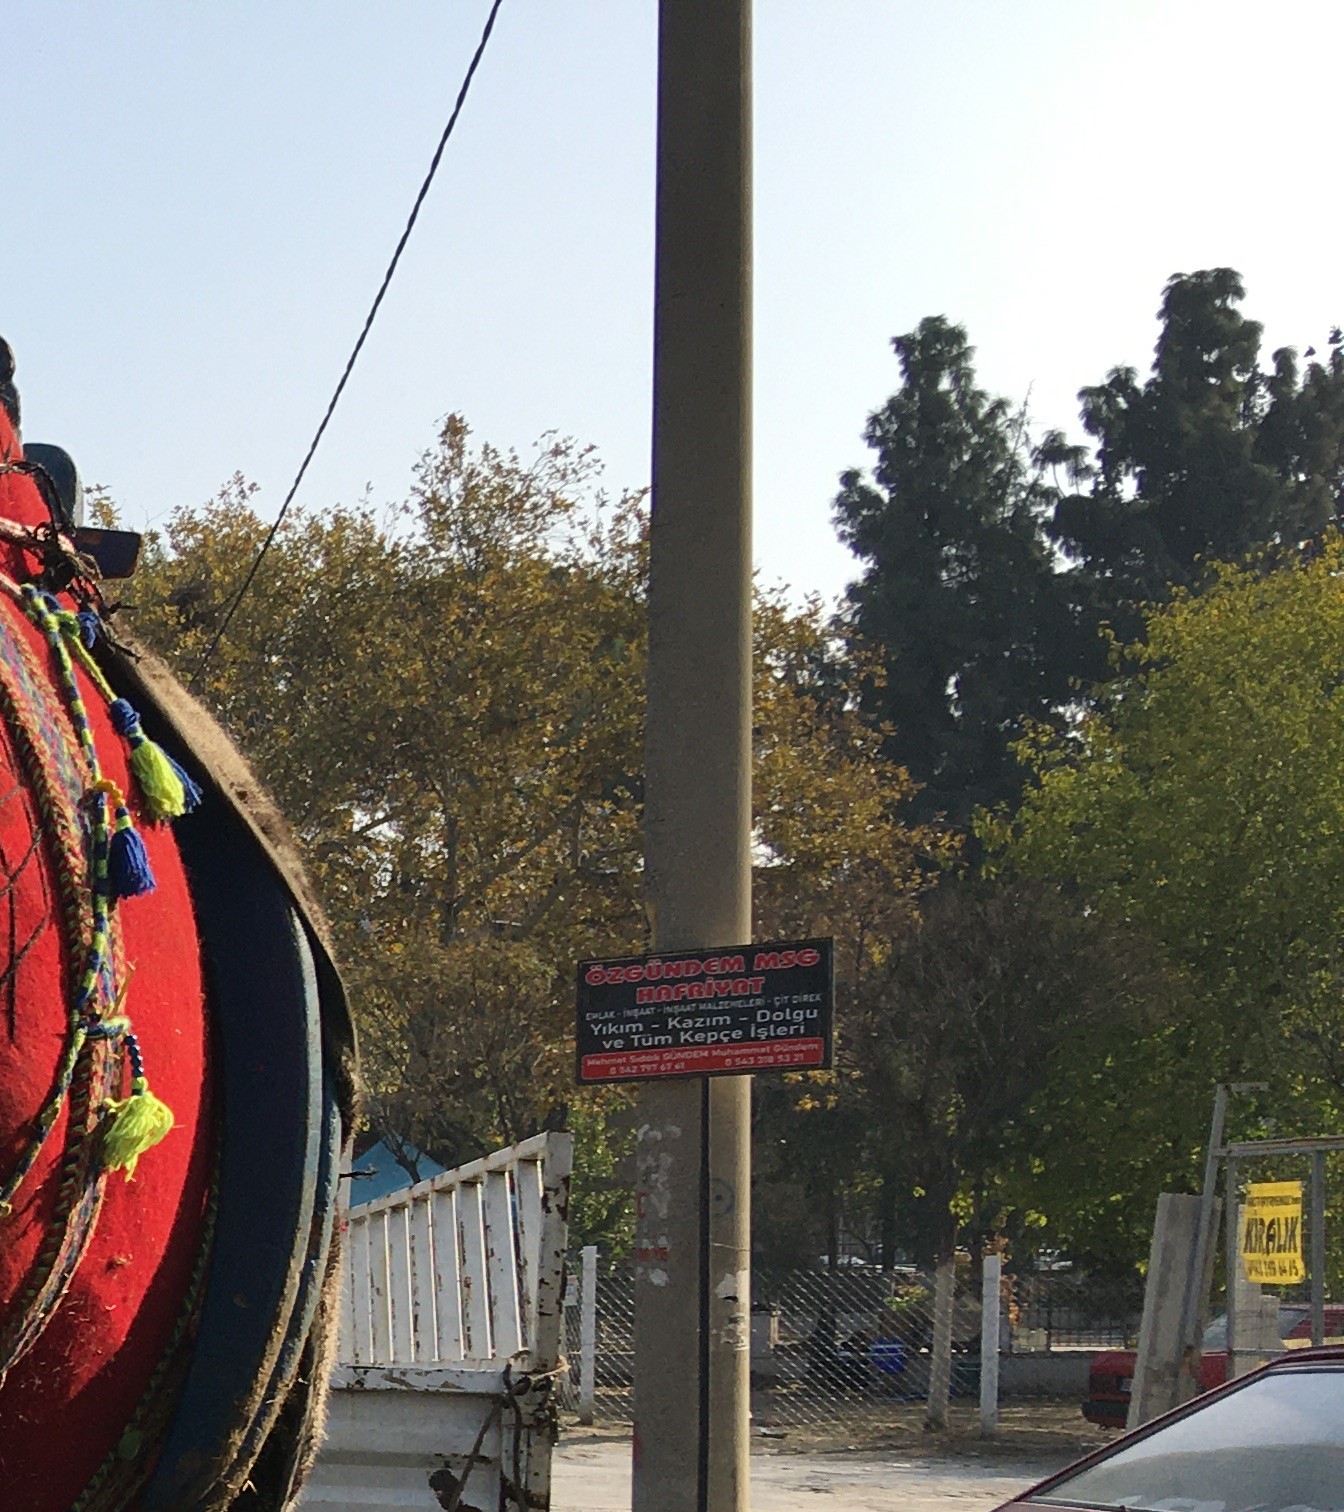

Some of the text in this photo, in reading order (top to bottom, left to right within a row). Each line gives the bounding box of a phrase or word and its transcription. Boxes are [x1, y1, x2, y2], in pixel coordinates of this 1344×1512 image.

[585, 948, 820, 986] ÖZGÜNDEM MSG
[636, 976, 765, 1004] HAFRİYAT
[591, 1021, 644, 1036] Yıkım
[668, 1015, 731, 1030] Kazım
[756, 1007, 818, 1023] Dolgu
[602, 1021, 805, 1049] ve Tüm Kepçe İşleri
[587, 1056, 627, 1066] Mehmet
[662, 1050, 709, 1061] GÜNDEM
[712, 1044, 770, 1056] Muhammet
[1243, 1210, 1300, 1256] KİRALIK
